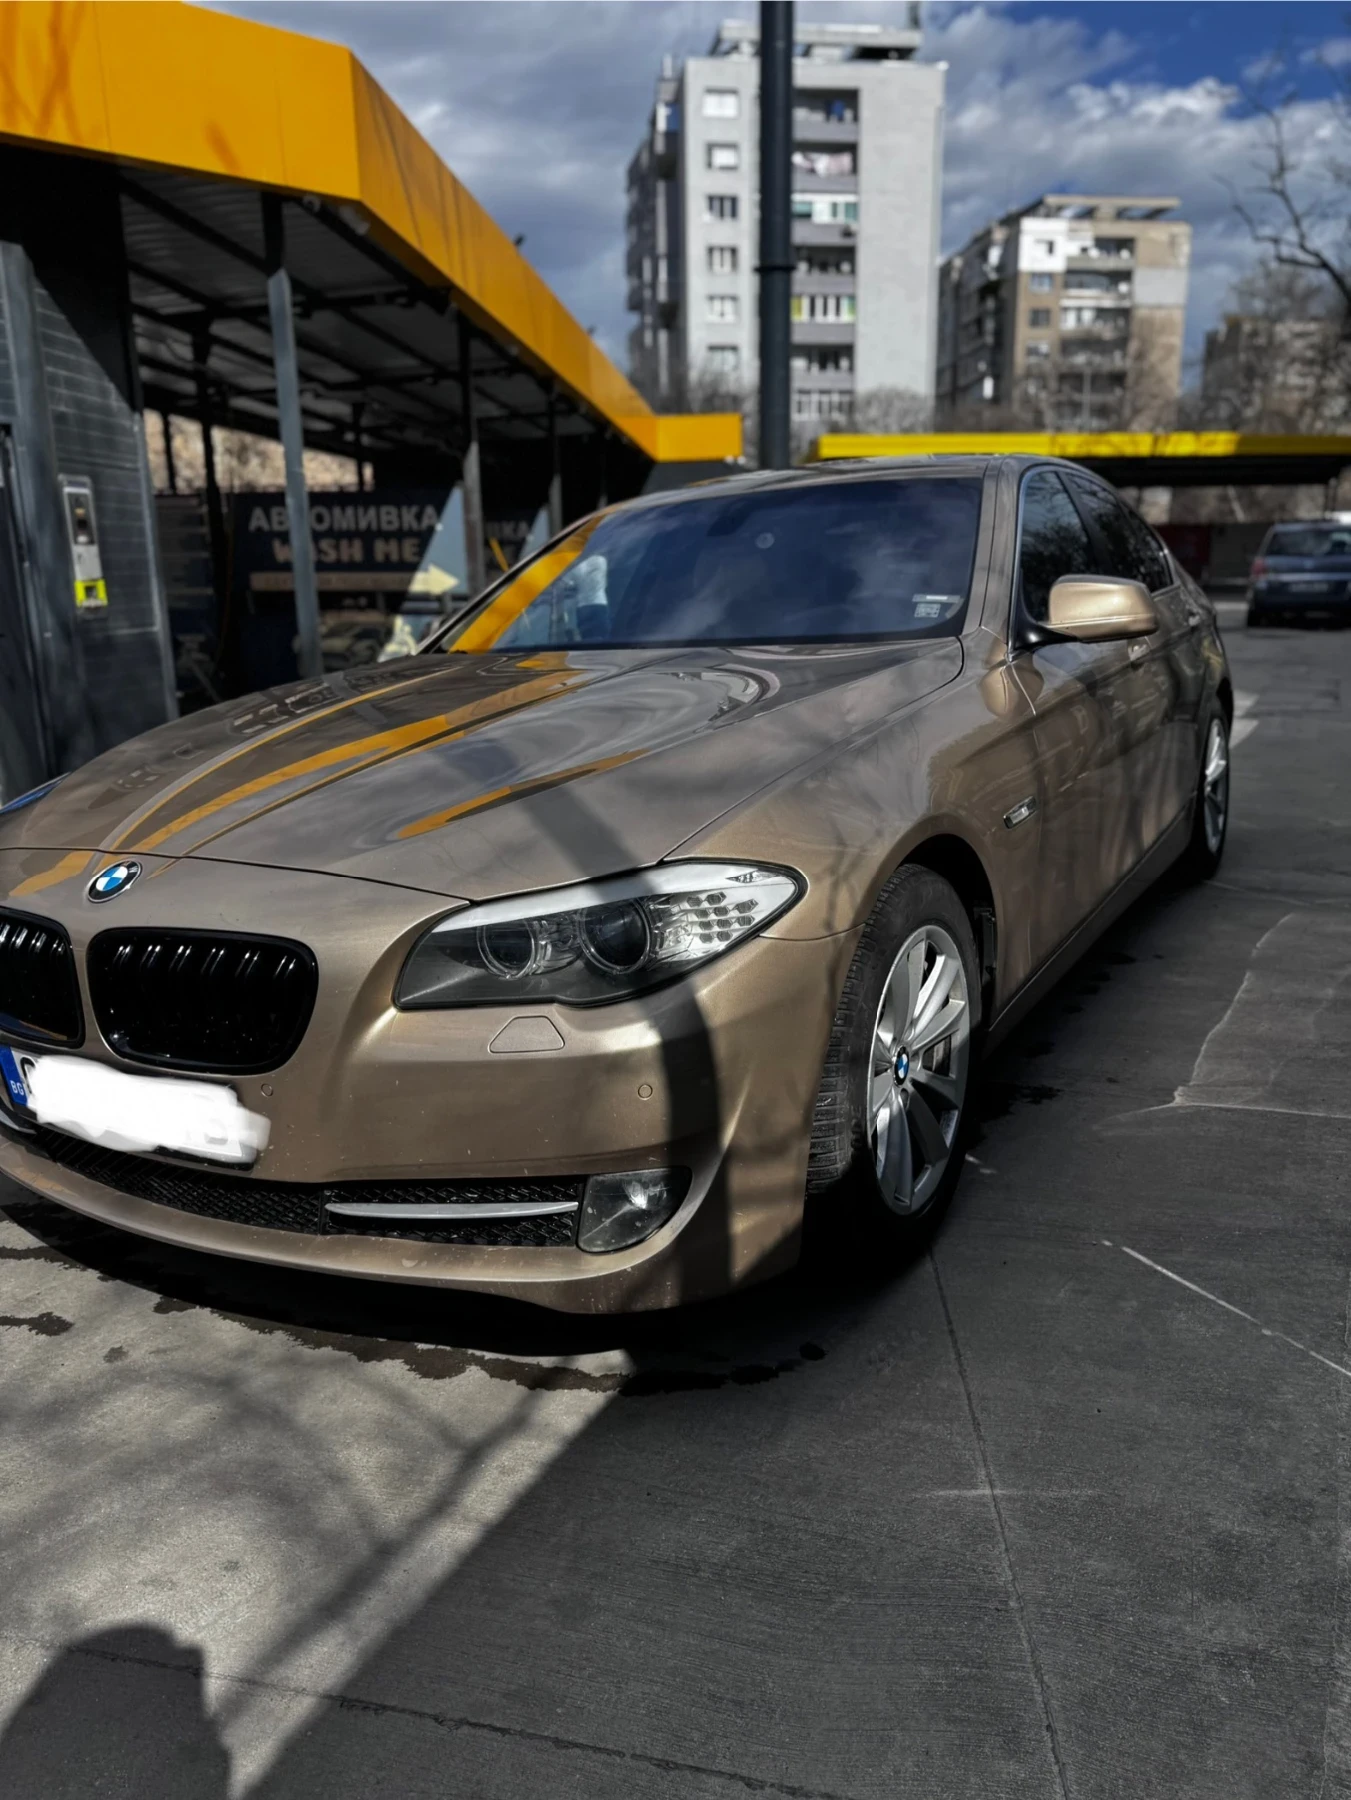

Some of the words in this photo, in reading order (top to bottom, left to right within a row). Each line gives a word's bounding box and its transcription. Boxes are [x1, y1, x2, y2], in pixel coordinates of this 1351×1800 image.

[248, 505, 439, 532] АВОМИВКА
[272, 538, 363, 563] WSH
[374, 537, 422, 563] ME
[9, 1079, 25, 1096] BG
